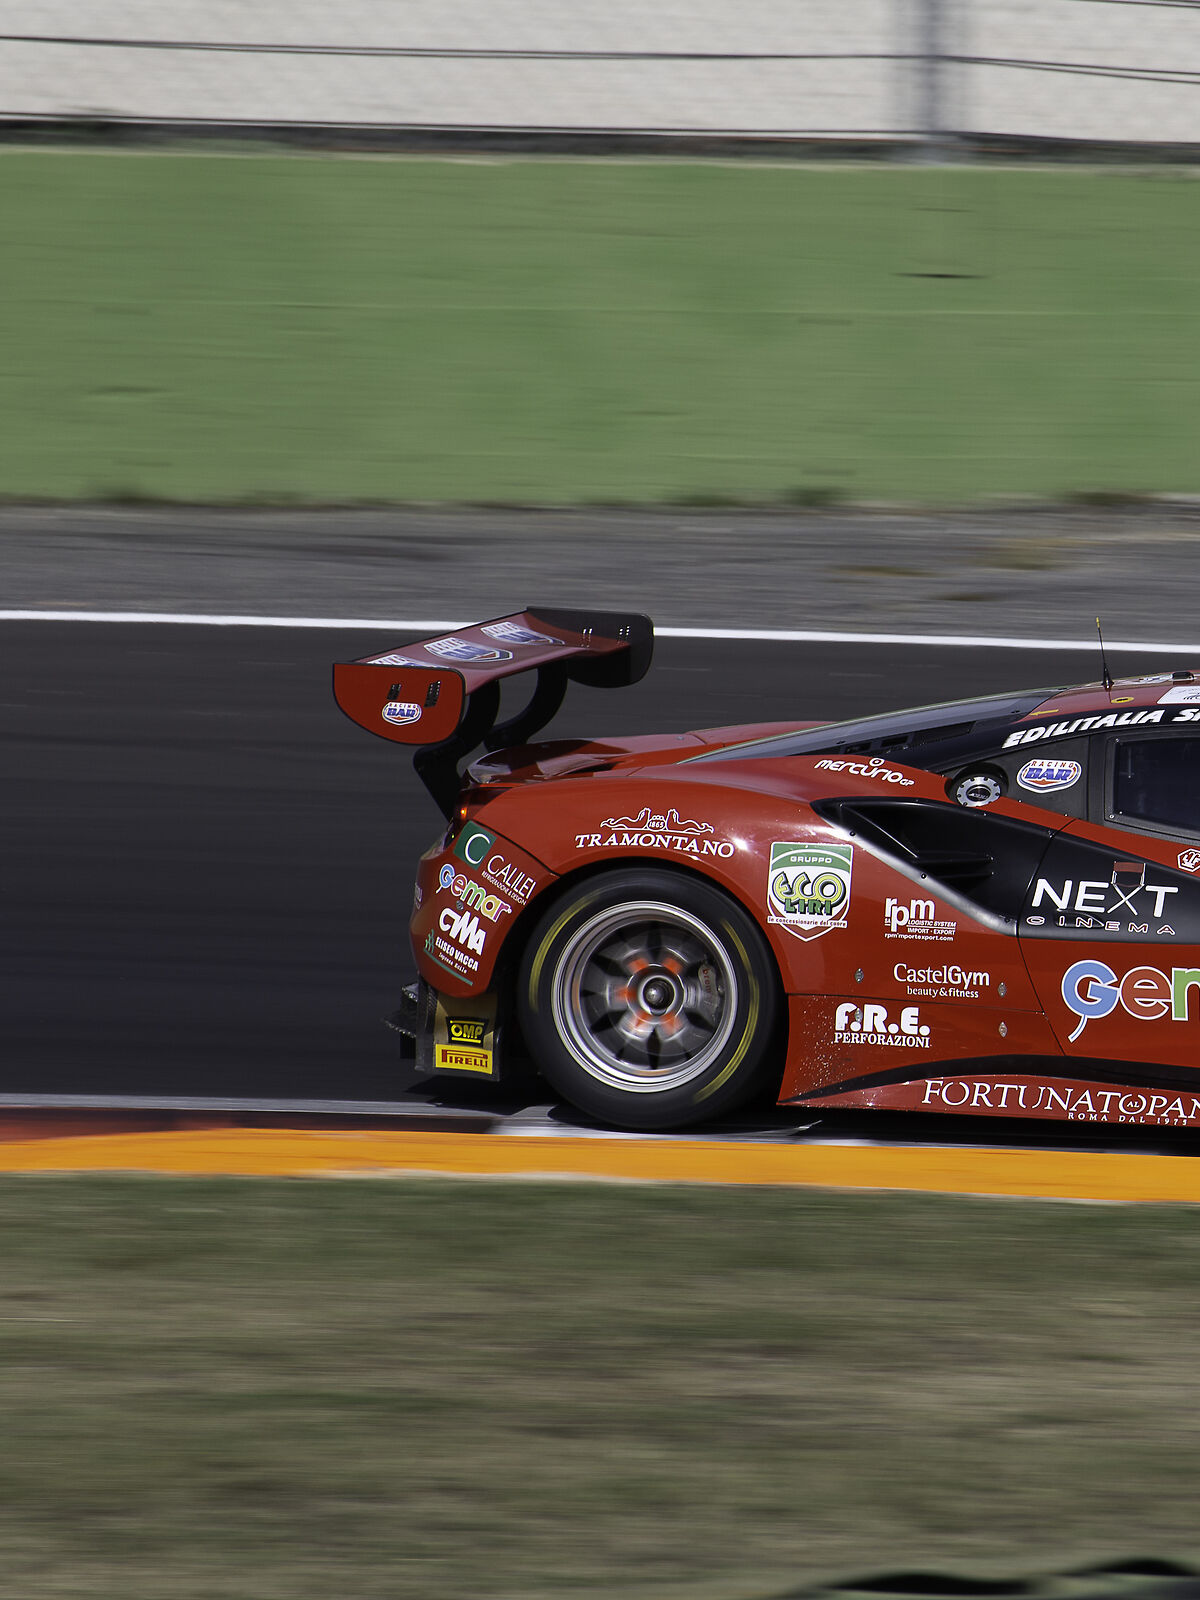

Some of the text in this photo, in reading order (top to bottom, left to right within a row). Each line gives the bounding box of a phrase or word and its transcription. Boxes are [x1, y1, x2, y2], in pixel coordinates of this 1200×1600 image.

[1001, 709, 1166, 749] EDILITALIA
[1025, 767, 1072, 780] BAR
[575, 833, 735, 858] TRAMONTANO
[772, 871, 846, 907] ECO
[1032, 877, 1178, 917] NEXT
[784, 898, 832, 915] LIRI
[885, 898, 935, 932] rpm
[1026, 915, 1176, 936] CINEMA
[435, 936, 479, 972] ELISEO VACCA
[894, 963, 990, 990] CastelGym
[451, 1023, 483, 1041] OMP
[834, 1032, 930, 1048] PERFORAZIONI
[441, 1049, 489, 1069] PIRELLI
[1067, 1112, 1188, 1126] ROMA DAL 1975
